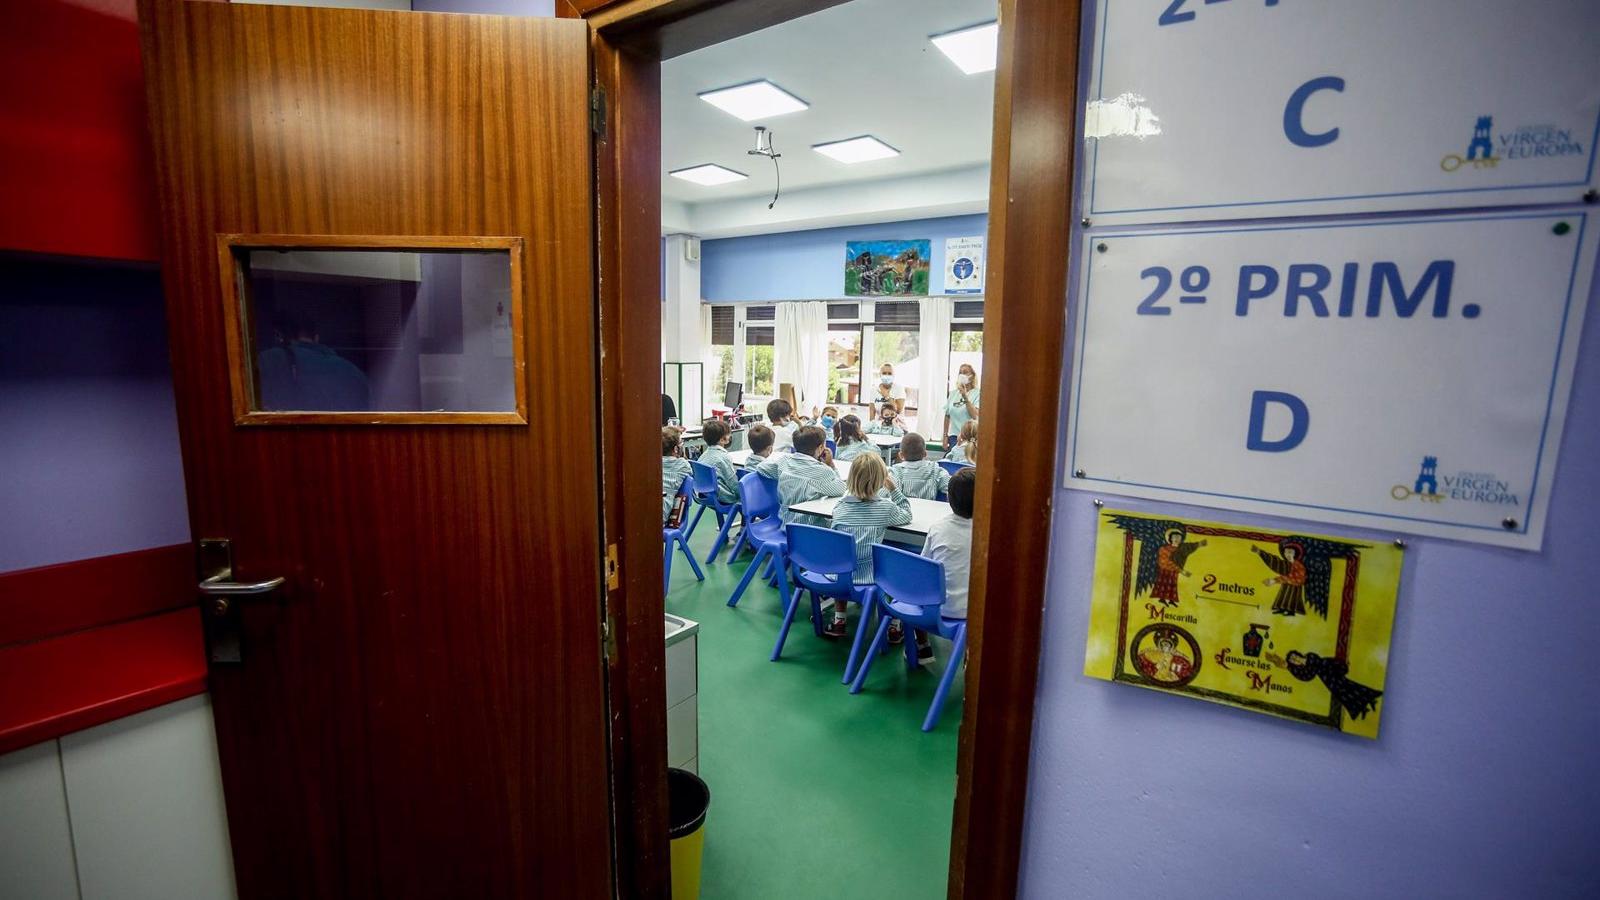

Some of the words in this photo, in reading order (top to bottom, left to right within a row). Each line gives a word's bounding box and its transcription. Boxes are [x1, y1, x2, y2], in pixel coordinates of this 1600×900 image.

[1283, 76, 1345, 148] C
[1499, 127, 1572, 146] VIRGEN
[1508, 142, 1585, 159] EUROPA
[1136, 265, 1211, 316] 2º
[1235, 260, 1482, 319] PRIM.
[1246, 390, 1310, 453] D
[1443, 475, 1509, 493] VIRGEN
[1451, 488, 1519, 506] EUROPA
[1201, 574, 1217, 593] 2
[1218, 582, 1255, 596] metros
[1145, 602, 1198, 624] Mascarilla
[1246, 670, 1293, 694] Manos
